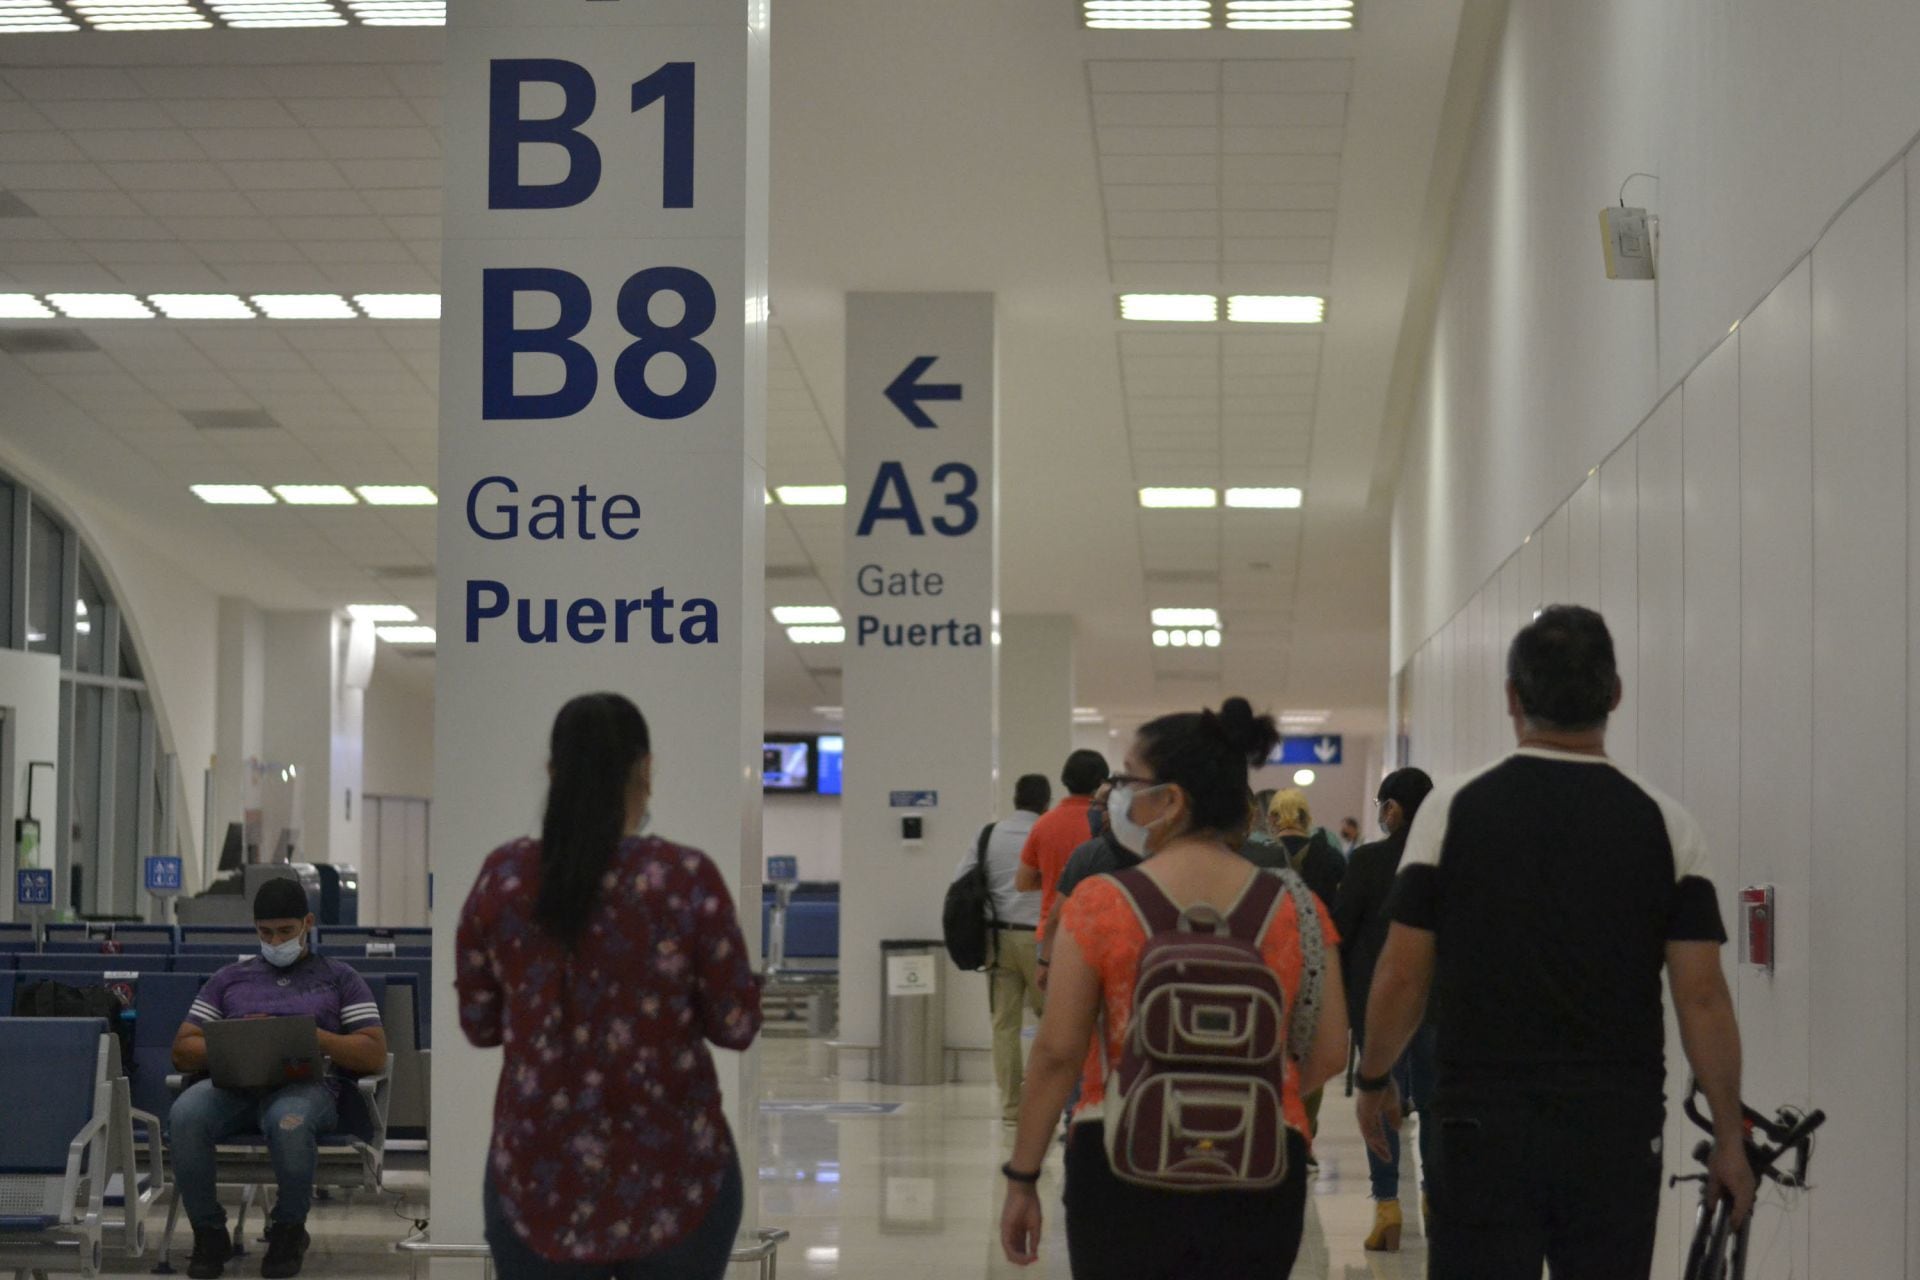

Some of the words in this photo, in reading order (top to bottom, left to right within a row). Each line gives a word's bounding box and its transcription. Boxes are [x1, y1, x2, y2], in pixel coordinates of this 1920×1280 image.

[487, 58, 696, 210] B1
[482, 266, 717, 421] B8
[466, 475, 641, 541] Gate
[856, 461, 979, 537] A3
[465, 579, 719, 645] Puerta
[856, 563, 944, 597] Gate
[857, 615, 982, 647] Puerta
